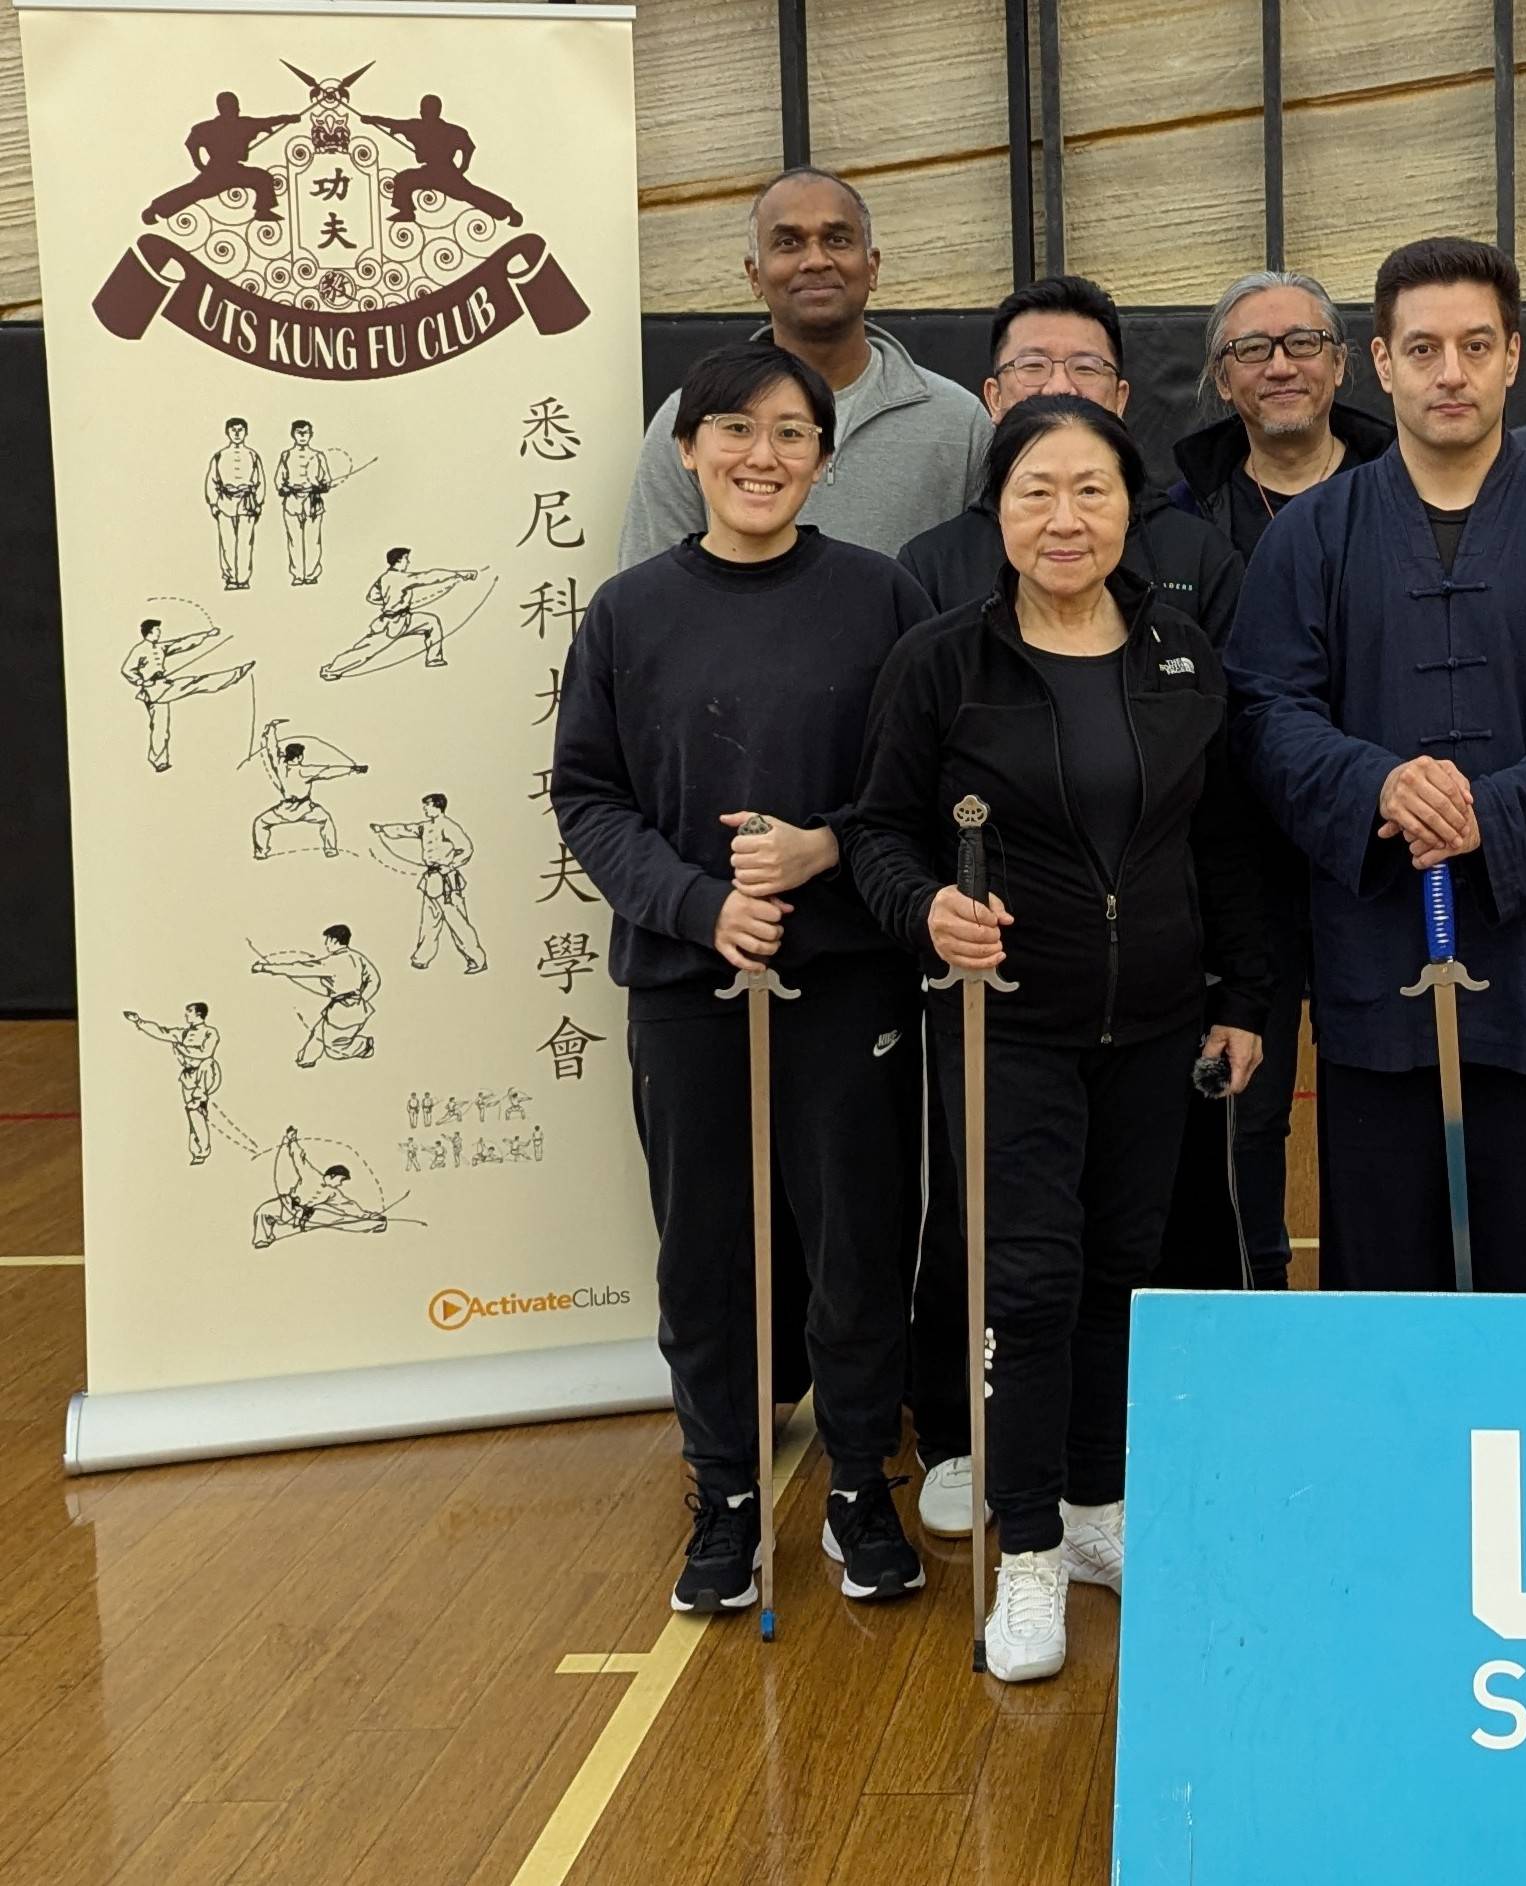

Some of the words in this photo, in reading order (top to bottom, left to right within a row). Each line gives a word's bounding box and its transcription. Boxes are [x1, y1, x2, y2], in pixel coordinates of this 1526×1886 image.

[309, 167, 357, 249] 功夫
[198, 283, 258, 354] UTS
[269, 318, 358, 371] KUNG
[368, 323, 407, 369] FU
[417, 286, 496, 360] CLUB
